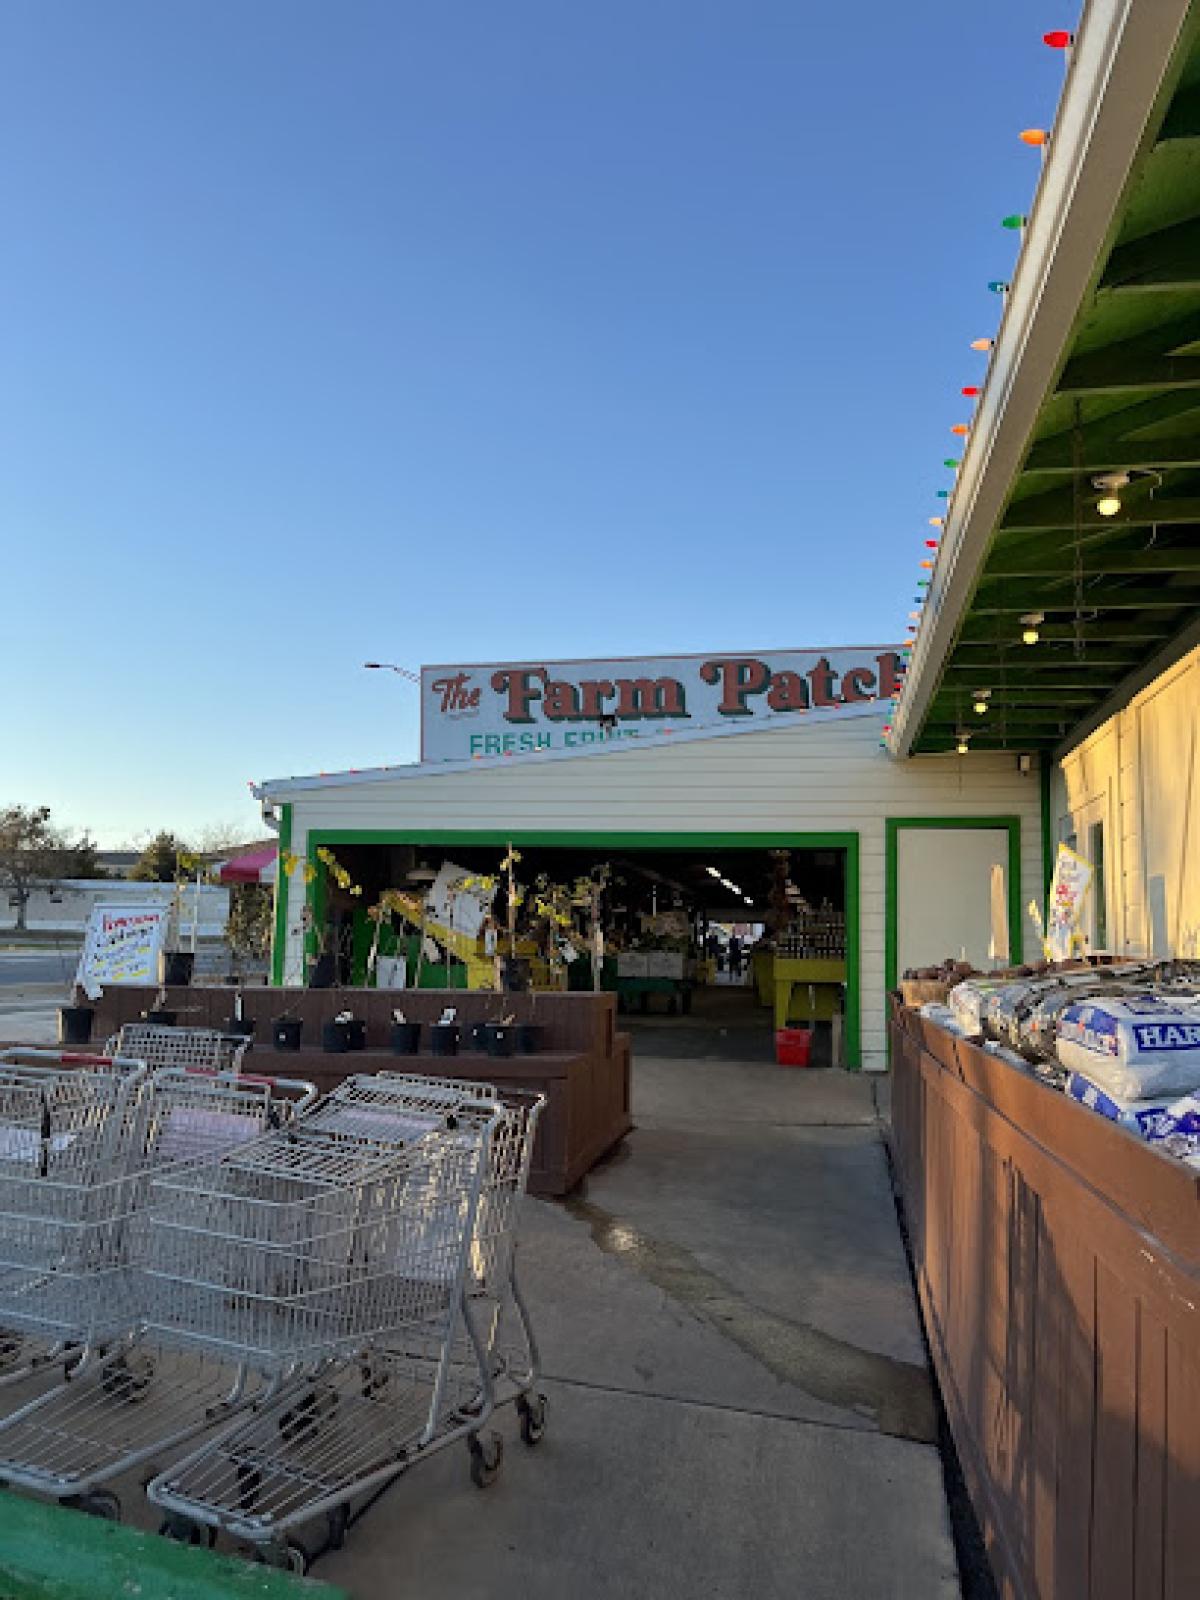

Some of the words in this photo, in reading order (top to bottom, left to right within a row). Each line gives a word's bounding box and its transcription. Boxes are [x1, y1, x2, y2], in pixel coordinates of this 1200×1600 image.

[431, 672, 482, 712] The
[491, 668, 691, 723] Farm
[469, 732, 551, 754] FRESH
